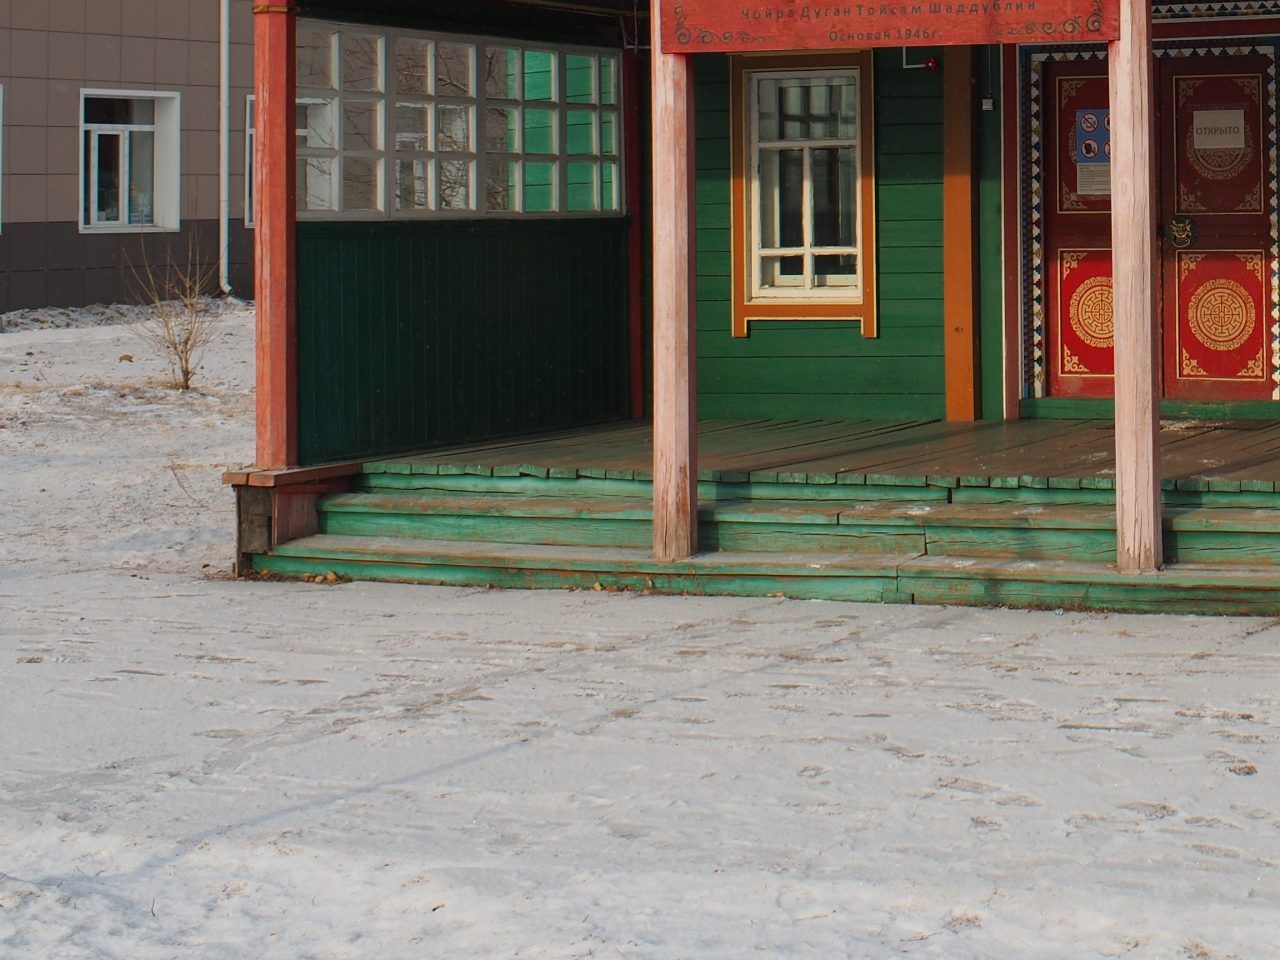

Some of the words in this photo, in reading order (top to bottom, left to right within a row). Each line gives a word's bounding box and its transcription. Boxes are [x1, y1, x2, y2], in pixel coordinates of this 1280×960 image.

[741, 6, 795, 21] Чойра
[800, 4, 852, 21] Дуган
[856, 1, 923, 16] Тойсам
[928, 0, 1037, 16] Шаддублин
[829, 29, 891, 43] Основан
[1195, 126, 1240, 136] ОТКРЫТО
